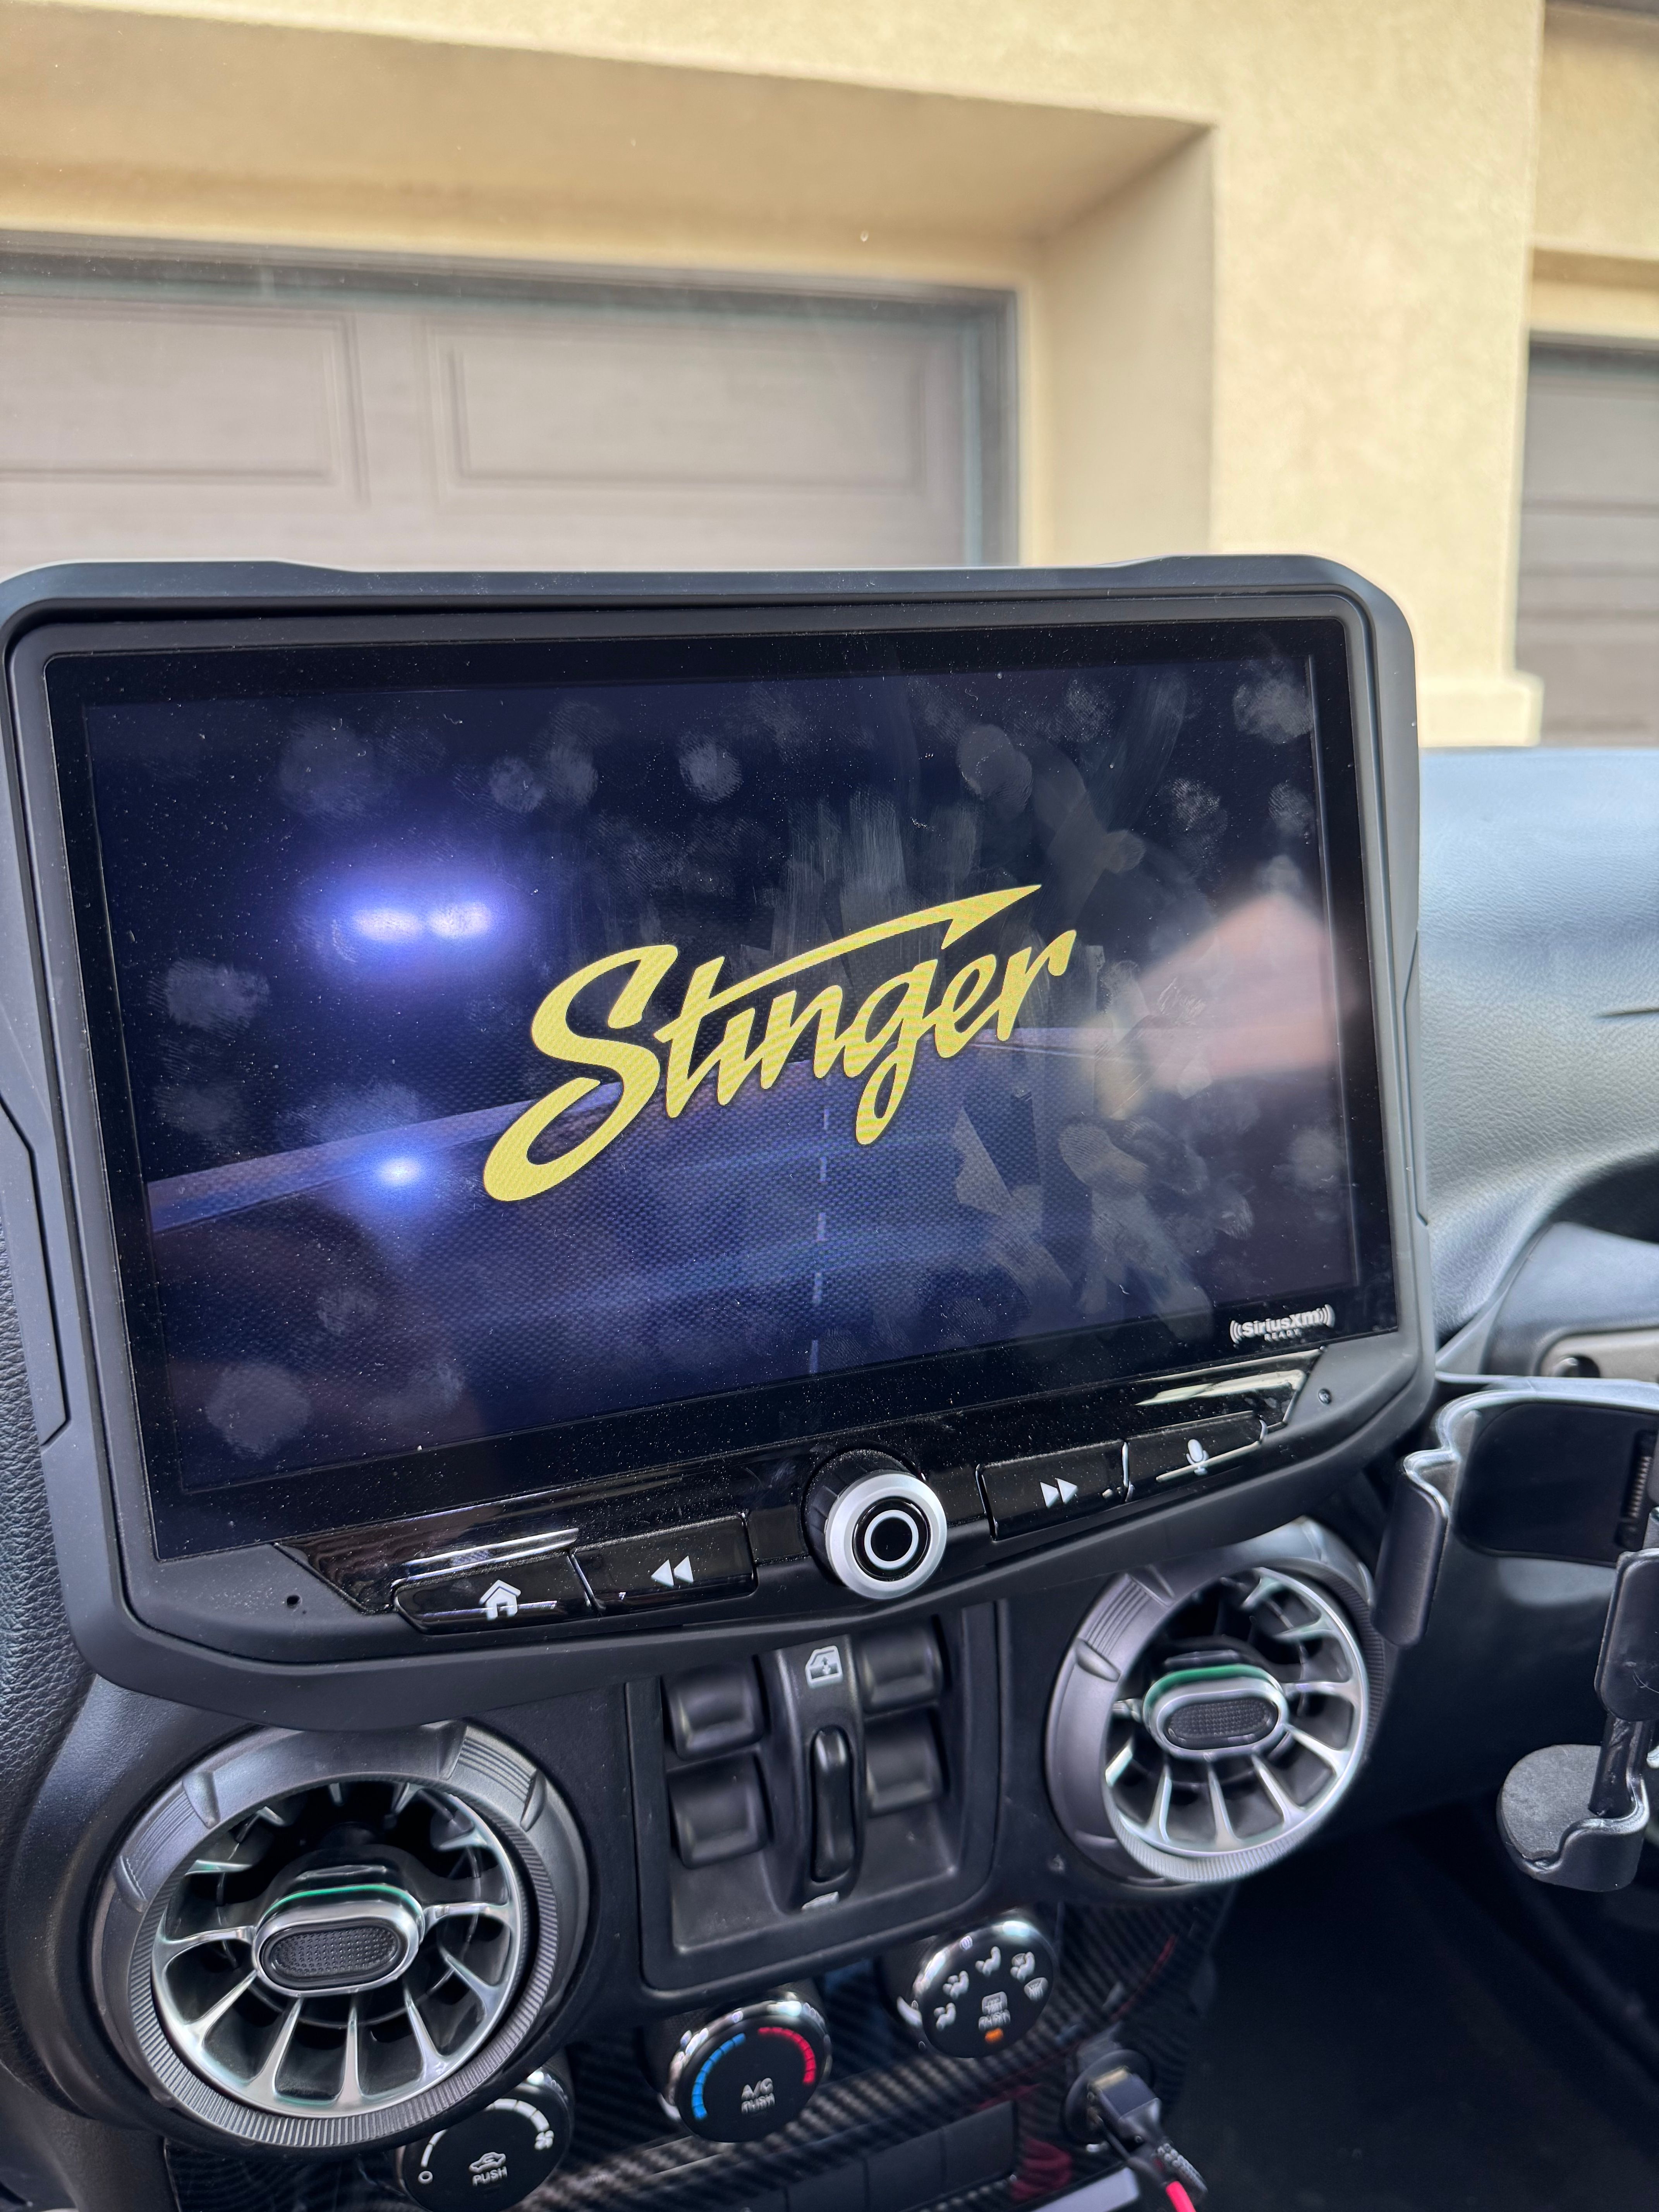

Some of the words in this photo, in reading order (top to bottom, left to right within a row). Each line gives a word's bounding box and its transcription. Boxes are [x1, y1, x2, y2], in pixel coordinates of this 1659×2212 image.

[483, 884, 1077, 1202] Stinger
[1264, 1328, 1302, 1343] READY
[741, 2078, 773, 2100] A/C
[472, 2167, 507, 2186] PUSH
